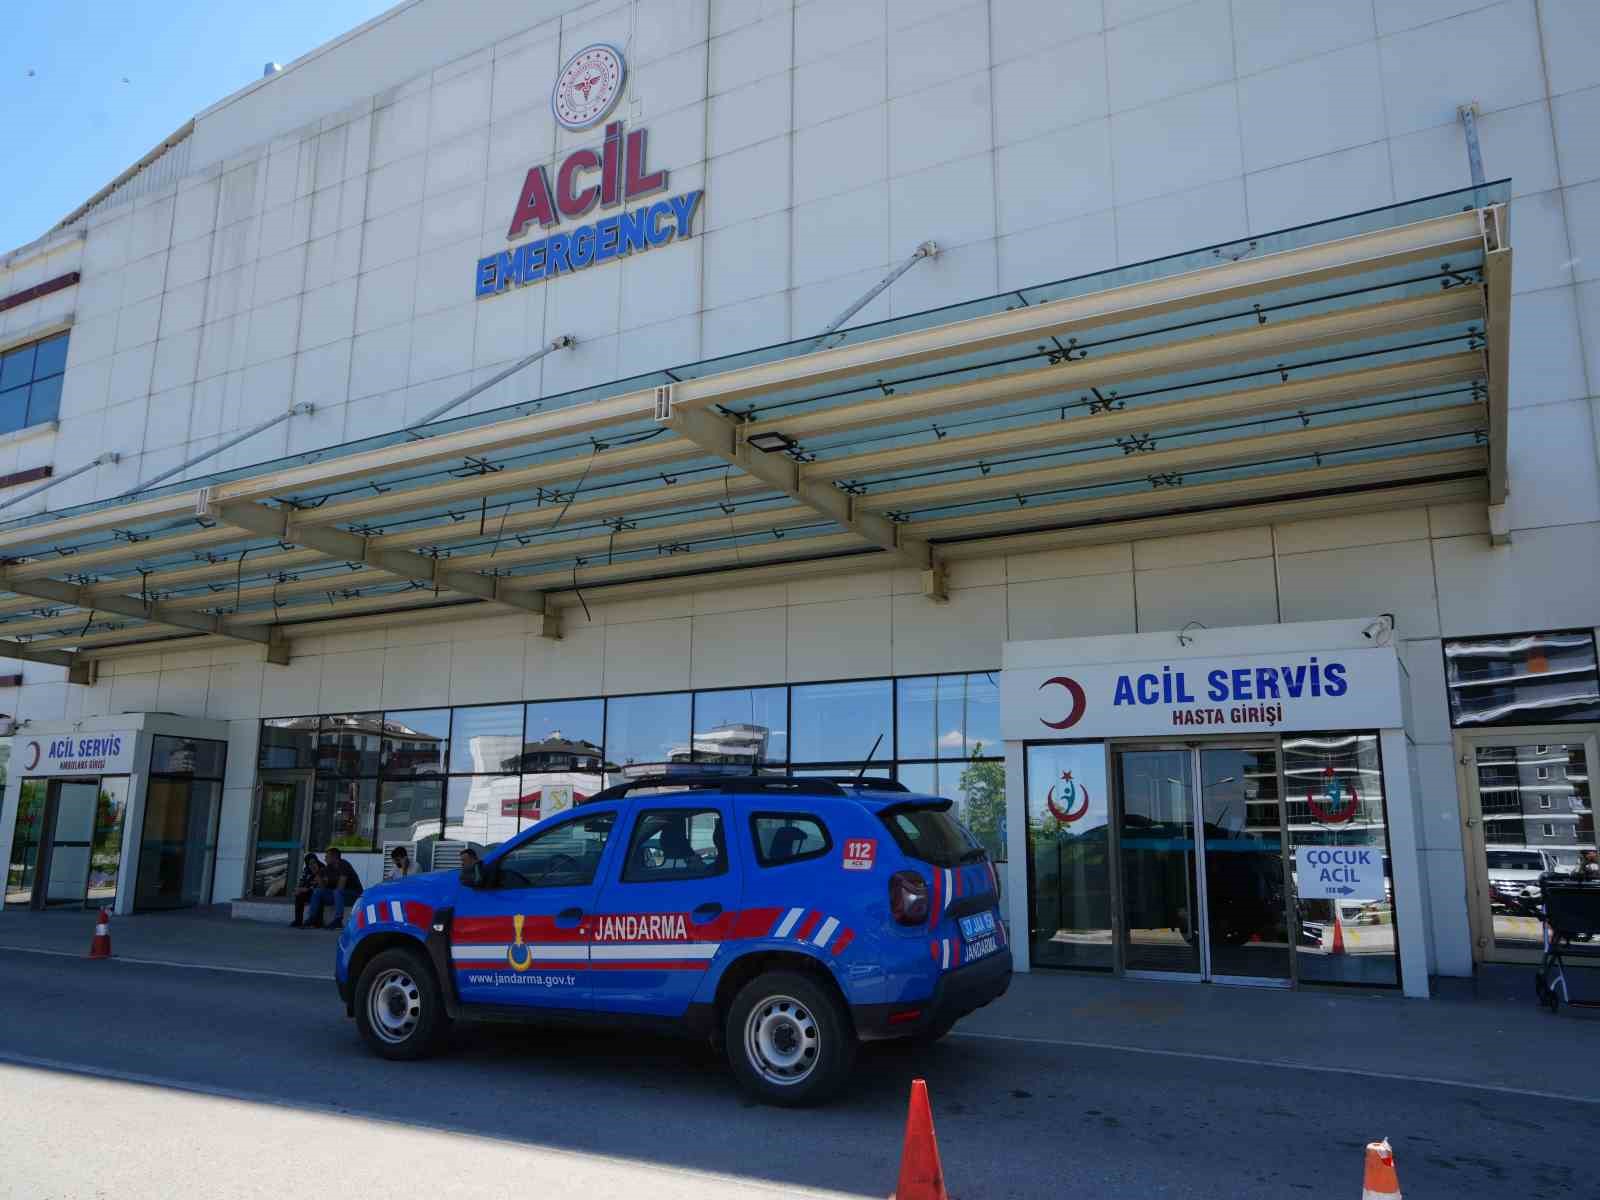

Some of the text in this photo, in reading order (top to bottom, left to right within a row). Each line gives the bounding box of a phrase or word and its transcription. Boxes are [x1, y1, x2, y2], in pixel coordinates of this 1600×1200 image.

[506, 119, 669, 241] ACİL
[475, 189, 704, 299] EMERGENCY
[1113, 656, 1348, 706] ACİL SERVİS
[1172, 702, 1283, 727] HASTA GİRİŞİ
[48, 733, 121, 759] ACİL SERVİS
[849, 842, 872, 858] 112
[1306, 850, 1371, 869] ÇOCUK
[1319, 865, 1361, 883] ACİL
[595, 915, 688, 941] JANDARMA
[468, 972, 576, 987] www.jandarma.gov.tr
